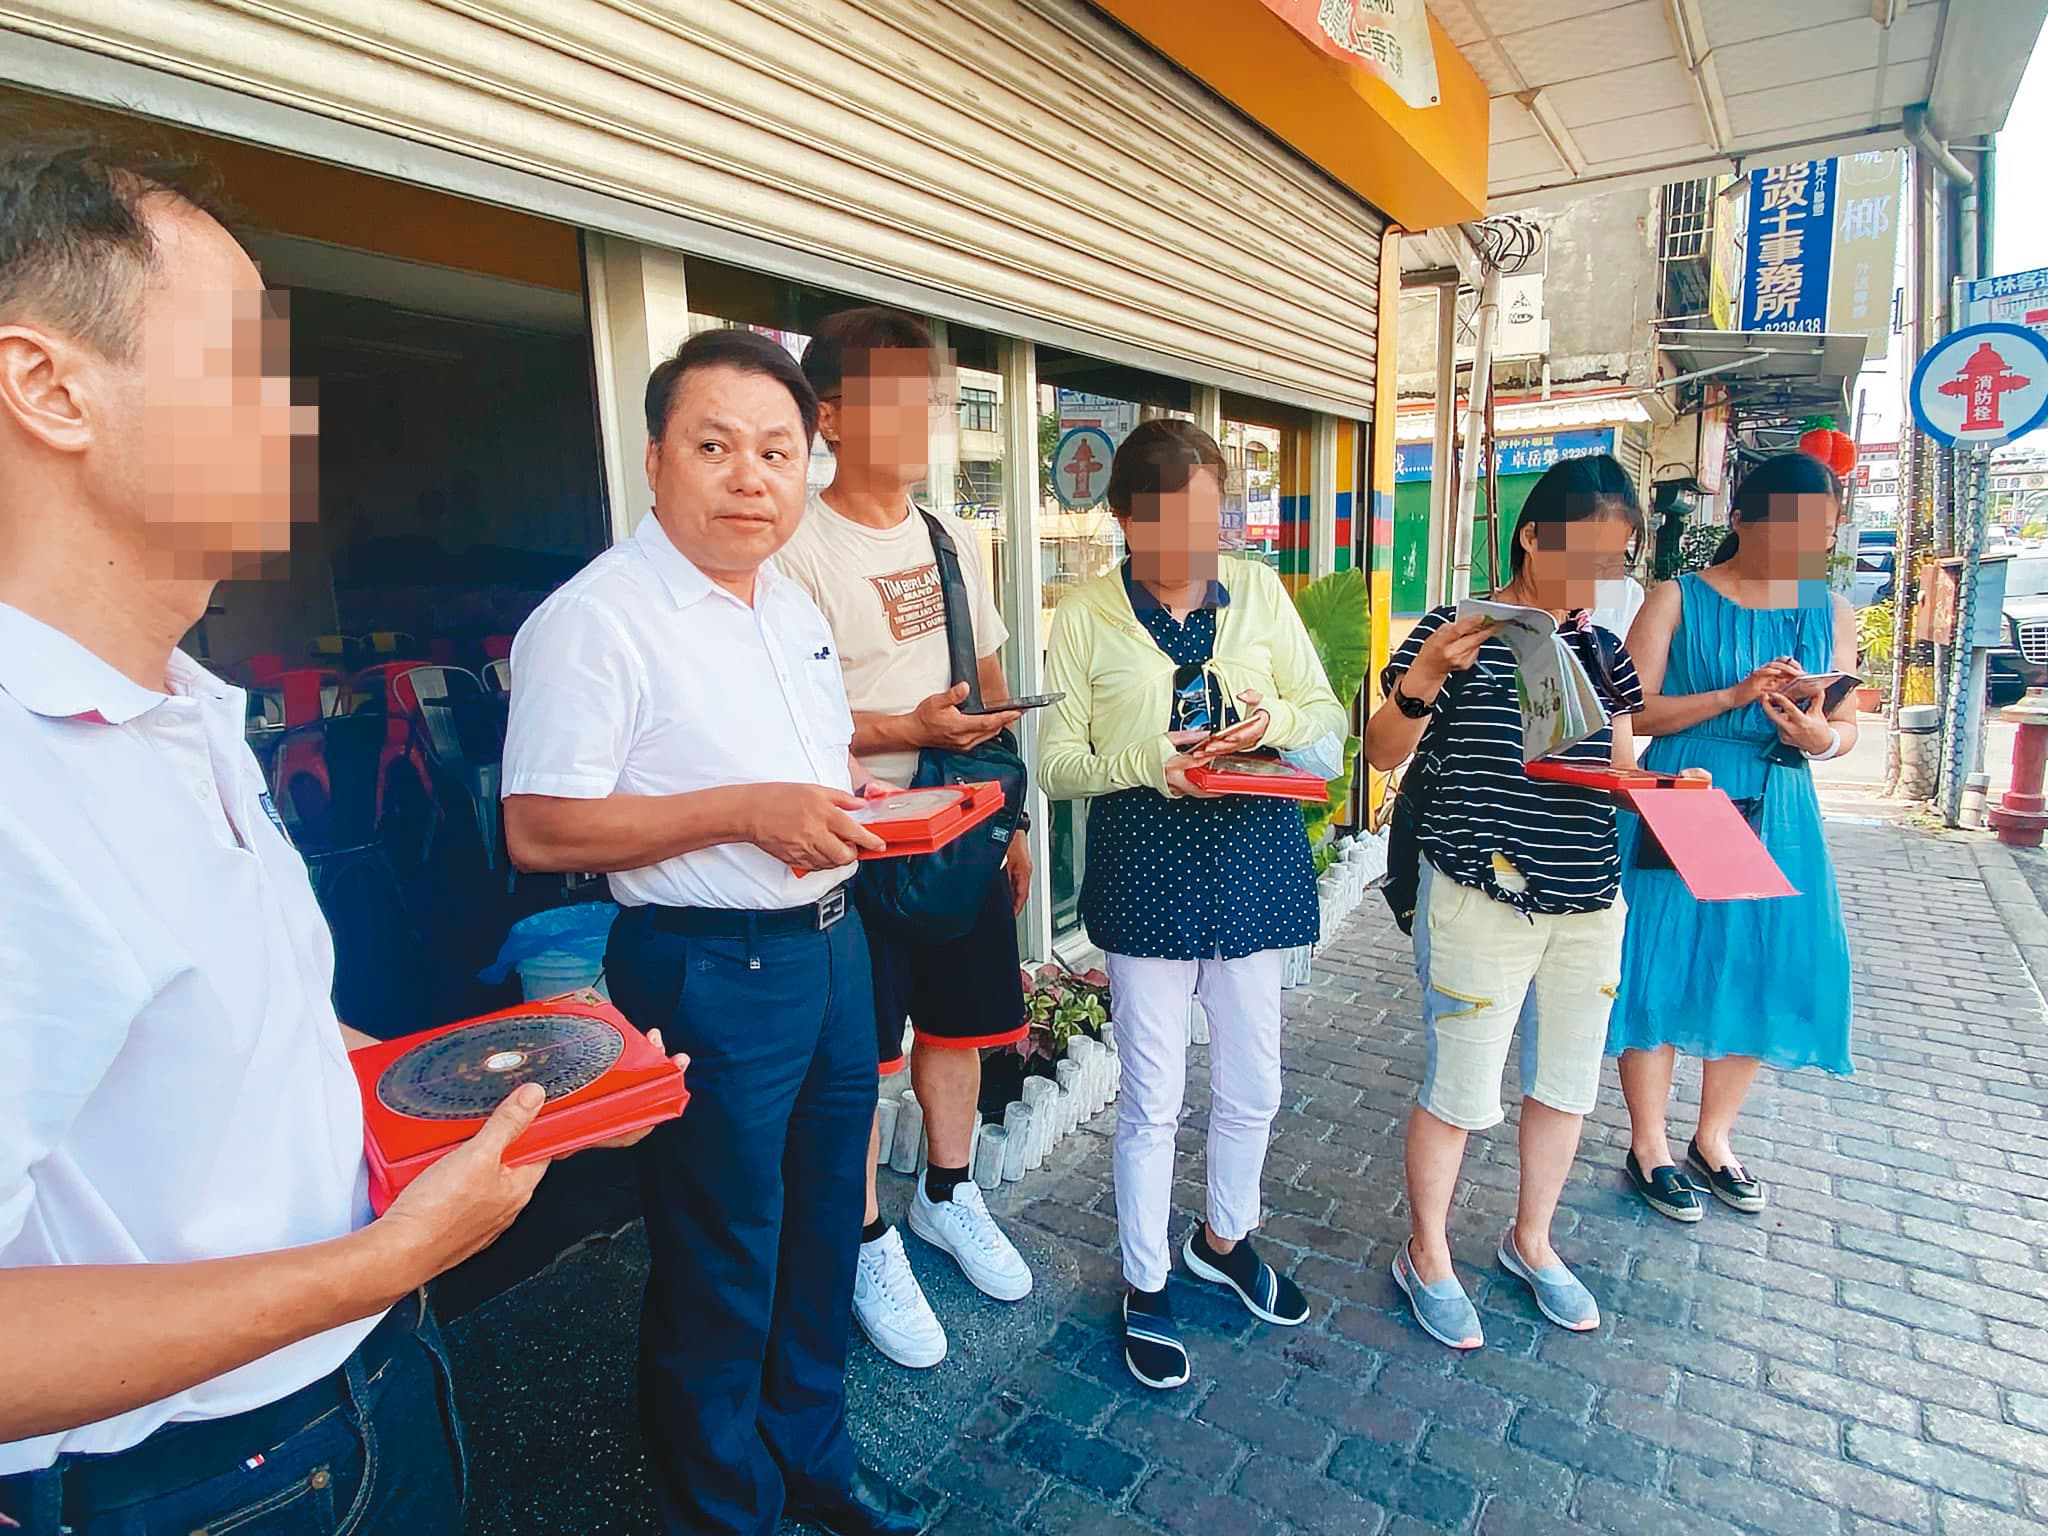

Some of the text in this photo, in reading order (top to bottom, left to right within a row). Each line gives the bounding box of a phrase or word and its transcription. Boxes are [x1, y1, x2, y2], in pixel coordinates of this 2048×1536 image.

[1973, 374, 1993, 421] 消防栓
[877, 564, 941, 602] TIMBERLAN
